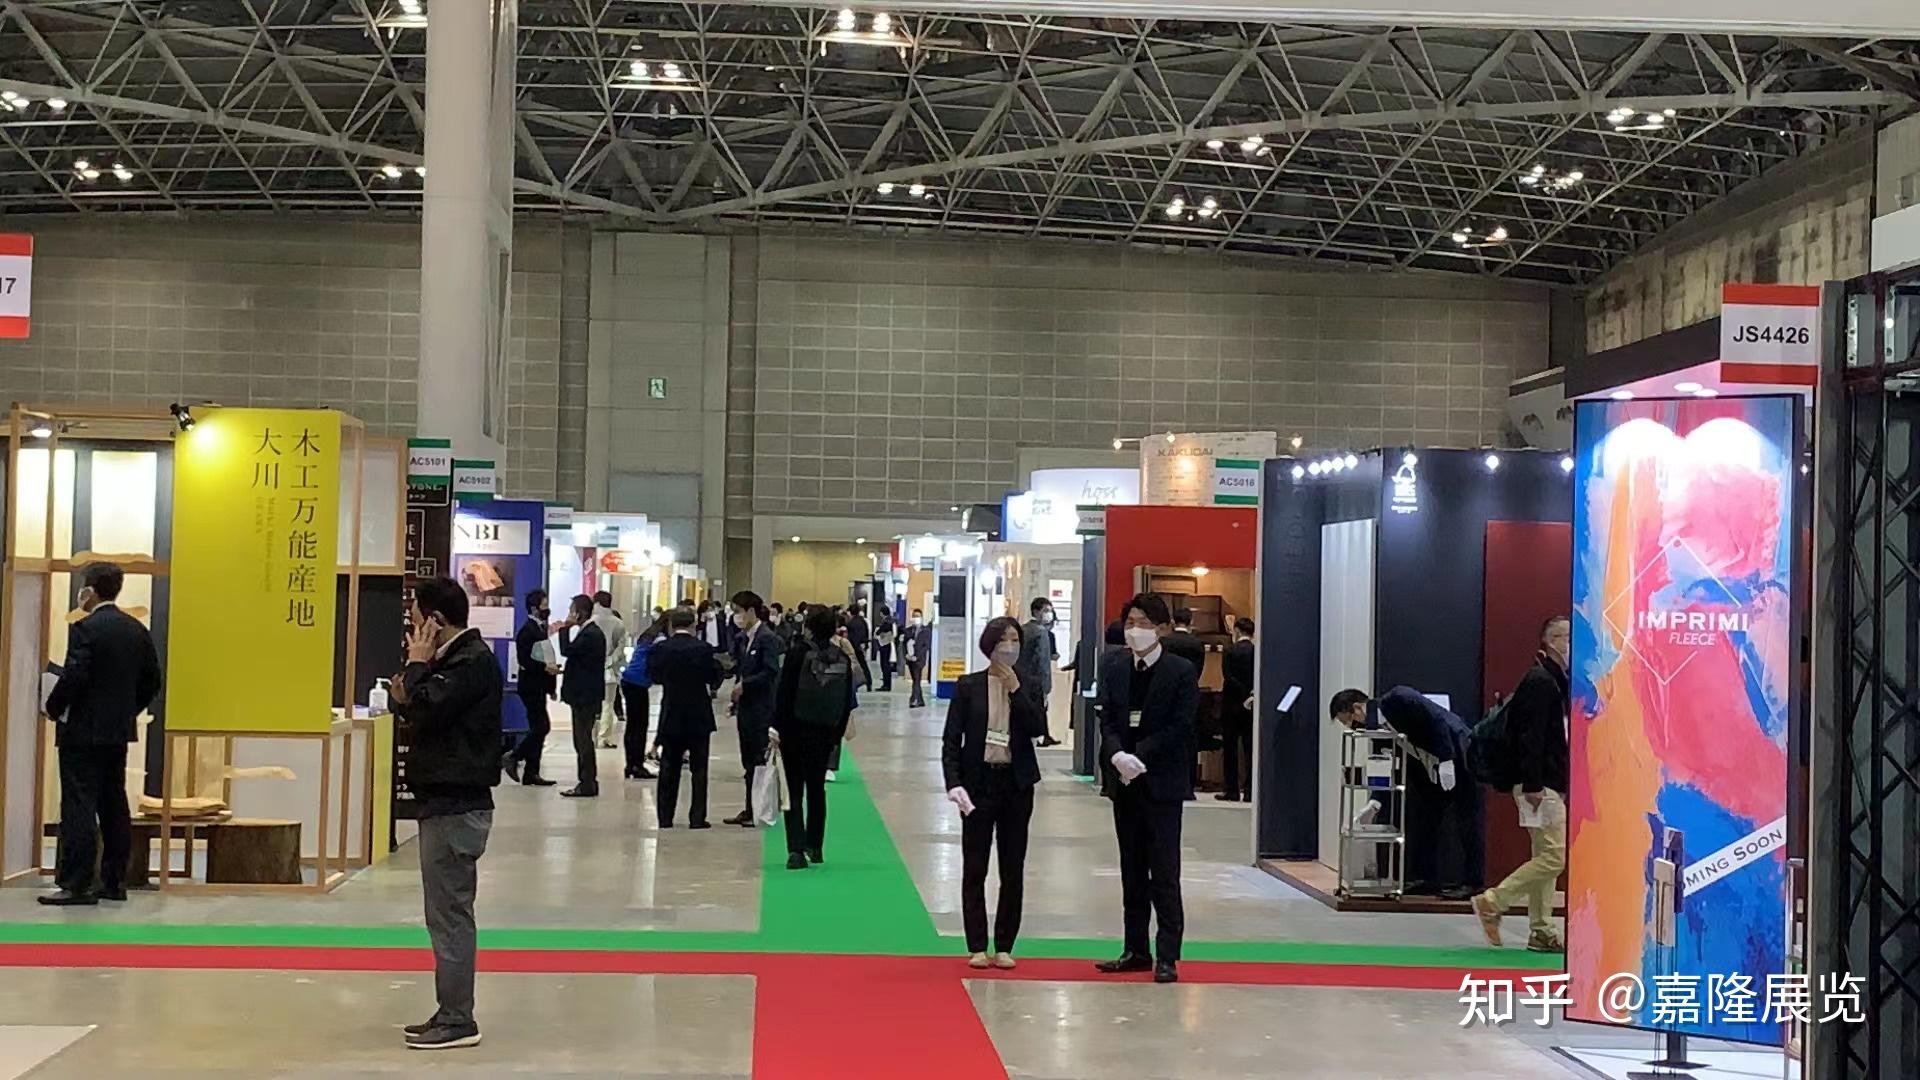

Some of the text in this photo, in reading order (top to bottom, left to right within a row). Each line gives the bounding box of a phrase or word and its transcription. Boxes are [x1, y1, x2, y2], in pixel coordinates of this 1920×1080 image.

[1732, 325, 1810, 345] JS4426
[252, 427, 283, 490] 大川
[410, 457, 446, 466] AC5101
[286, 427, 321, 628] 木工万能産地
[1638, 611, 1749, 632] IMPRIMI
[1668, 632, 1717, 646] FLEECE
[1733, 828, 1783, 861] SOON
